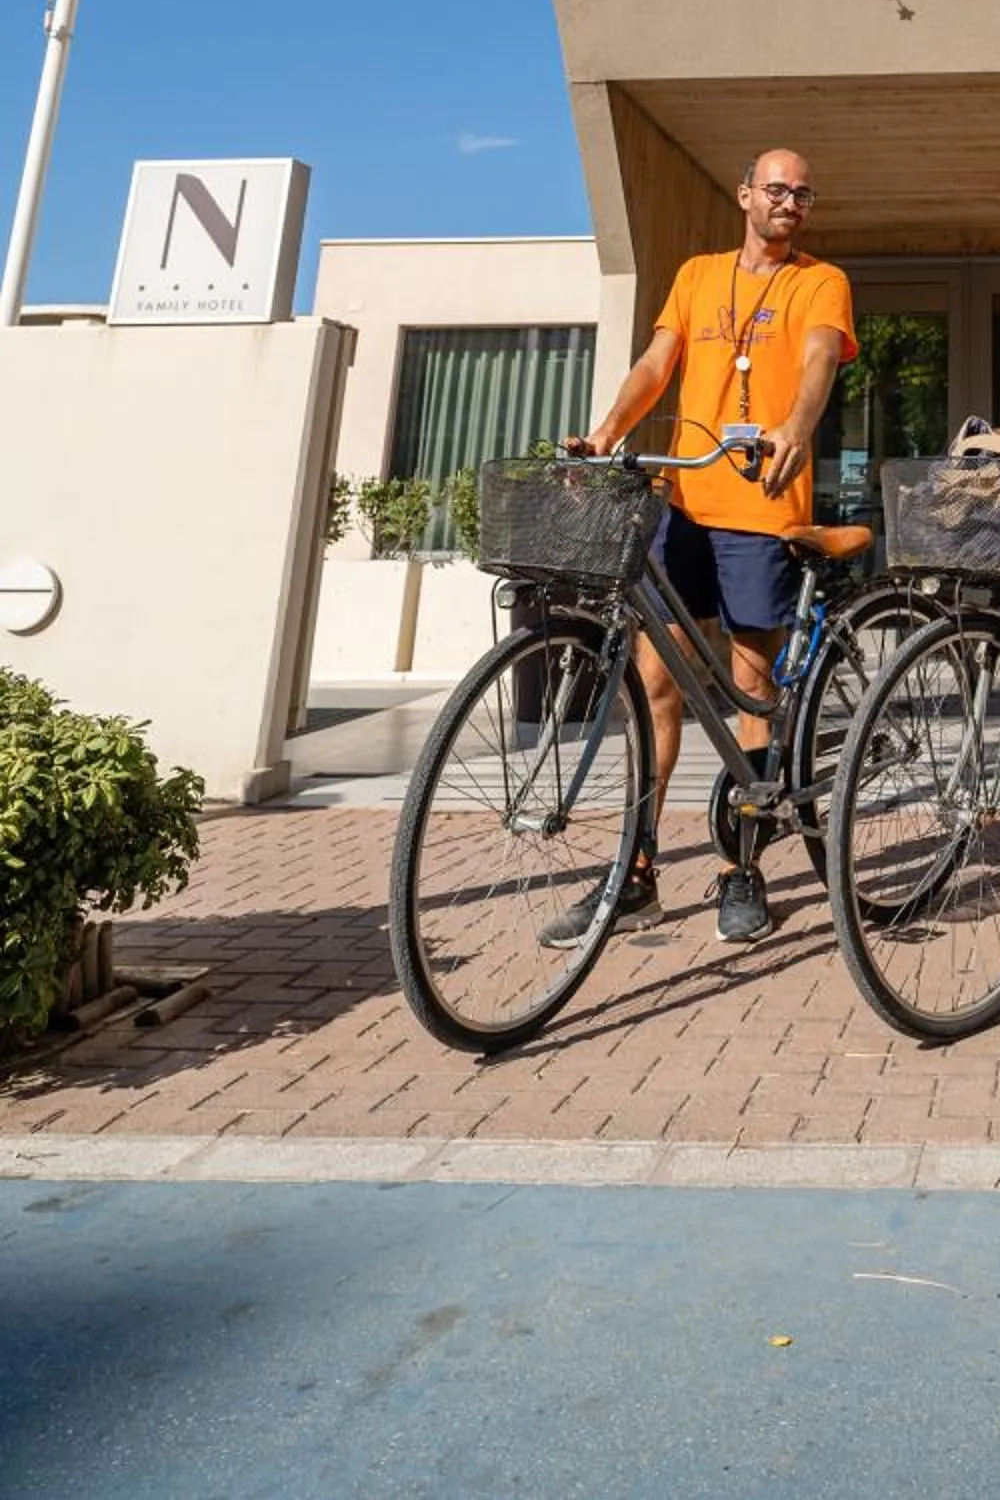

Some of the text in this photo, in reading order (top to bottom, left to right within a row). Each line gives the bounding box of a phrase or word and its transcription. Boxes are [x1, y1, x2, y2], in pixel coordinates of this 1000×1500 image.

[160, 173, 248, 269] N
[137, 299, 245, 312] FAMILY HOTEL
